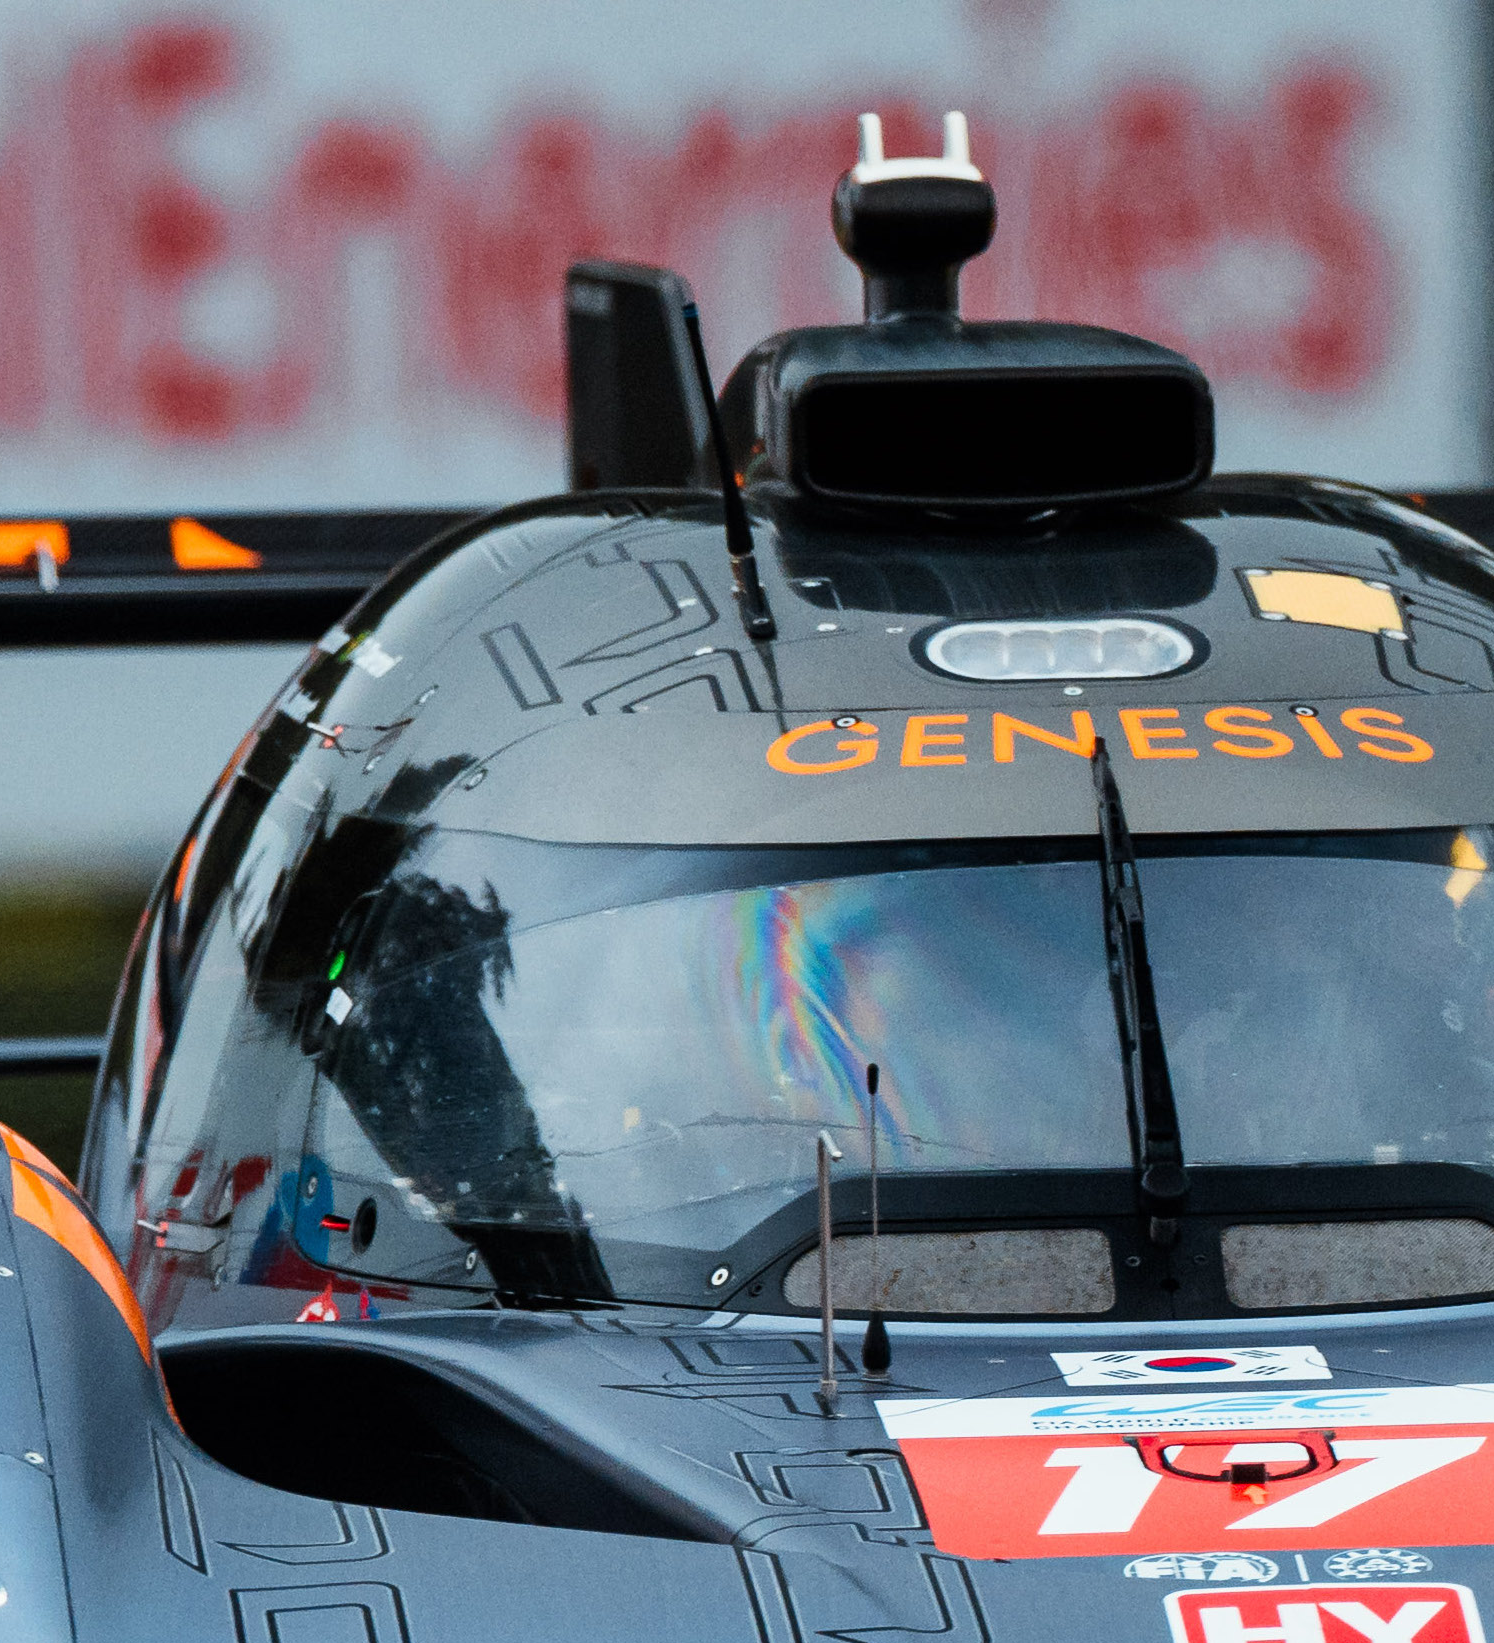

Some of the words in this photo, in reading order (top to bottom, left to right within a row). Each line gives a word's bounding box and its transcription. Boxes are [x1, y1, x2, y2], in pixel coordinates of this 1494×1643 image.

[765, 706, 1435, 775] GENESIS
[1030, 1392, 1389, 1417] WEC
[1034, 1420, 1254, 1430] CHAMPIONSHIP
[1198, 1412, 1372, 1422] ENDURANCE
[1037, 1436, 1487, 1536] 17
[1134, 1559, 1261, 1581] FIA
